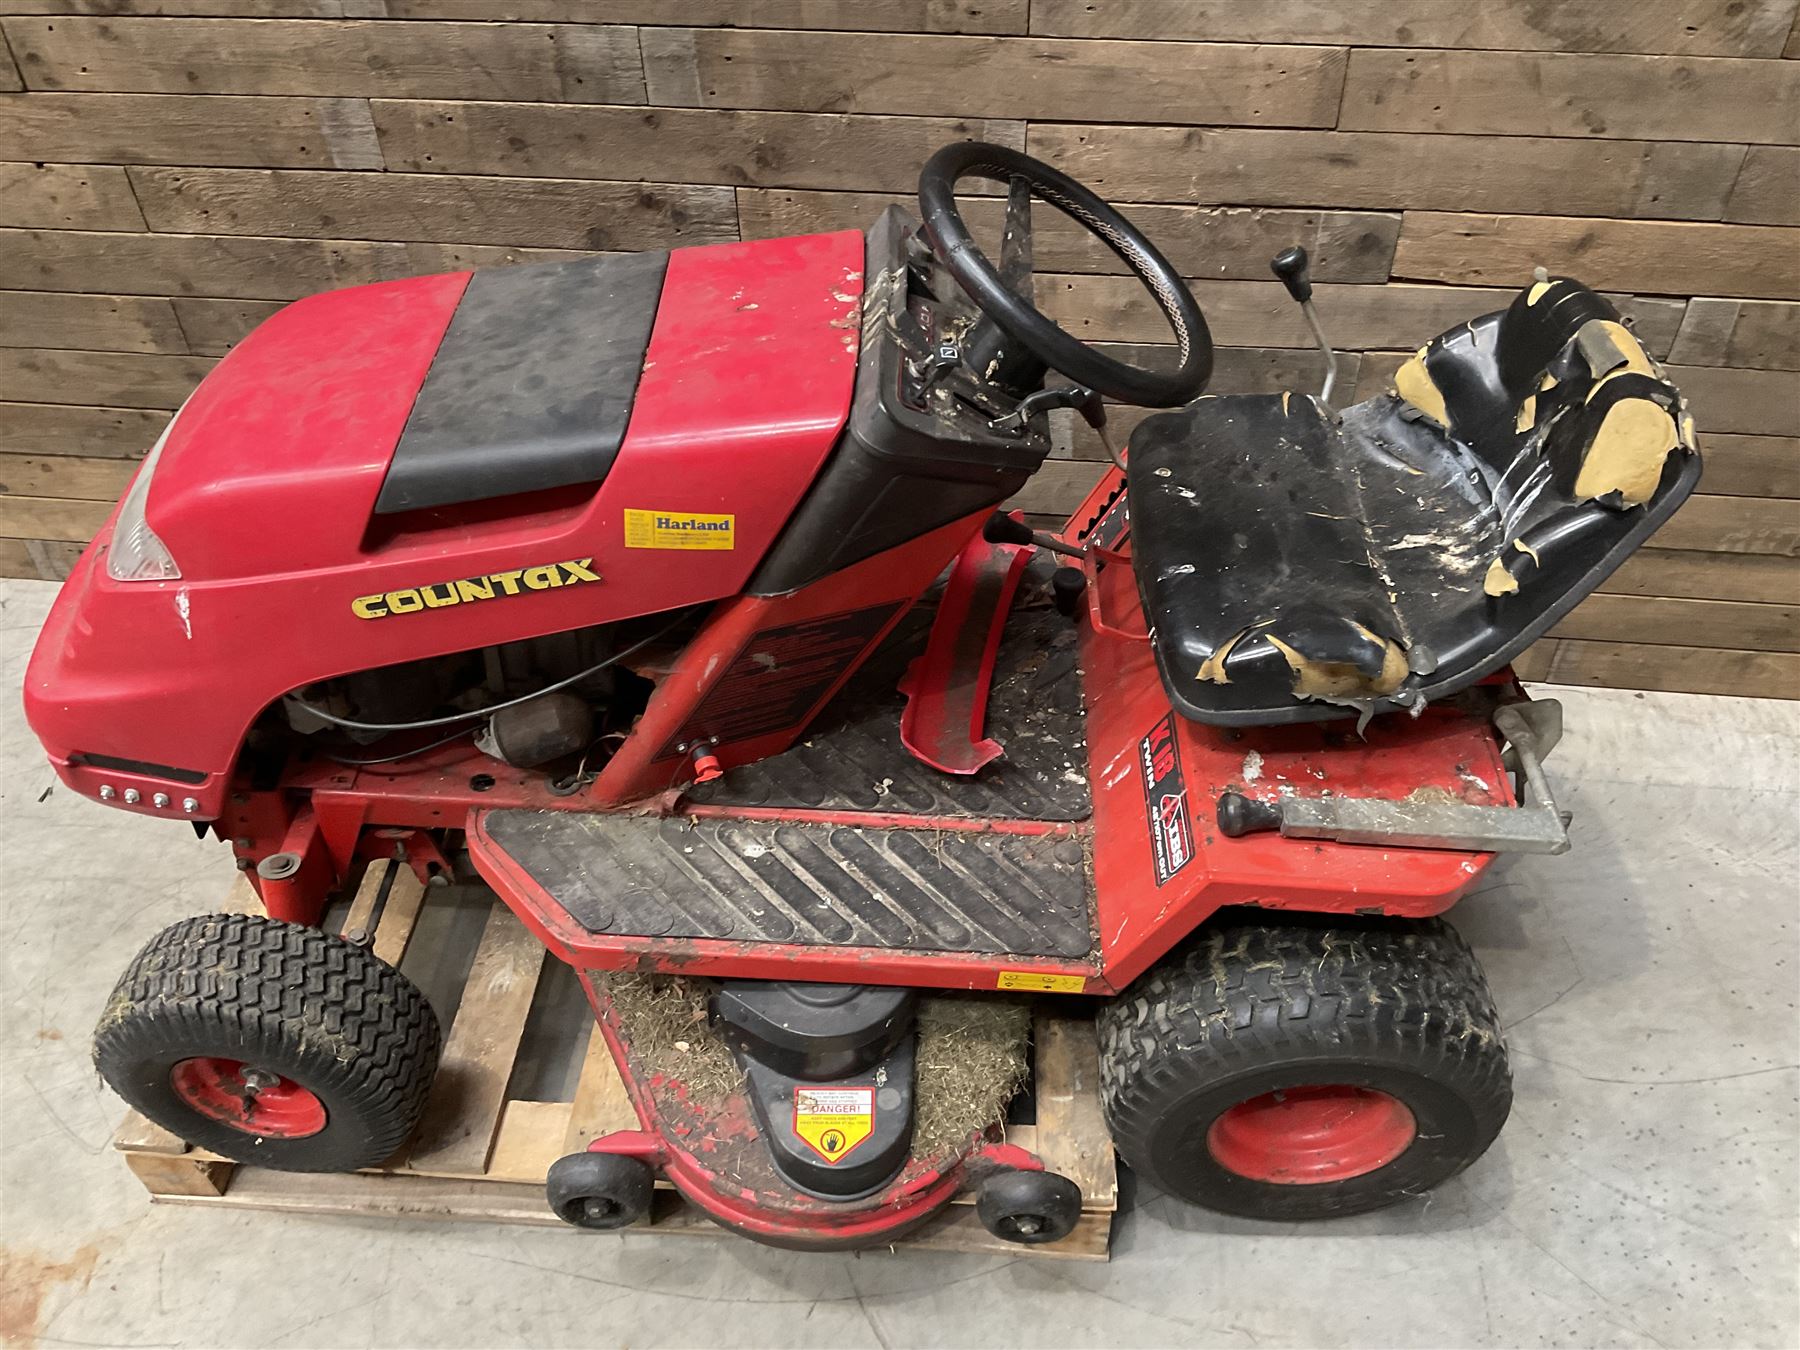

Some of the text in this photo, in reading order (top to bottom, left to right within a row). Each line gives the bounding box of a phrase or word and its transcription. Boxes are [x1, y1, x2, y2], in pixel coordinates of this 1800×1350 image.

[656, 517, 730, 531] Harland
[351, 557, 601, 619] COUNTAX
[1143, 737, 1156, 790] TWIN
[812, 1105, 860, 1113] DANGER!
